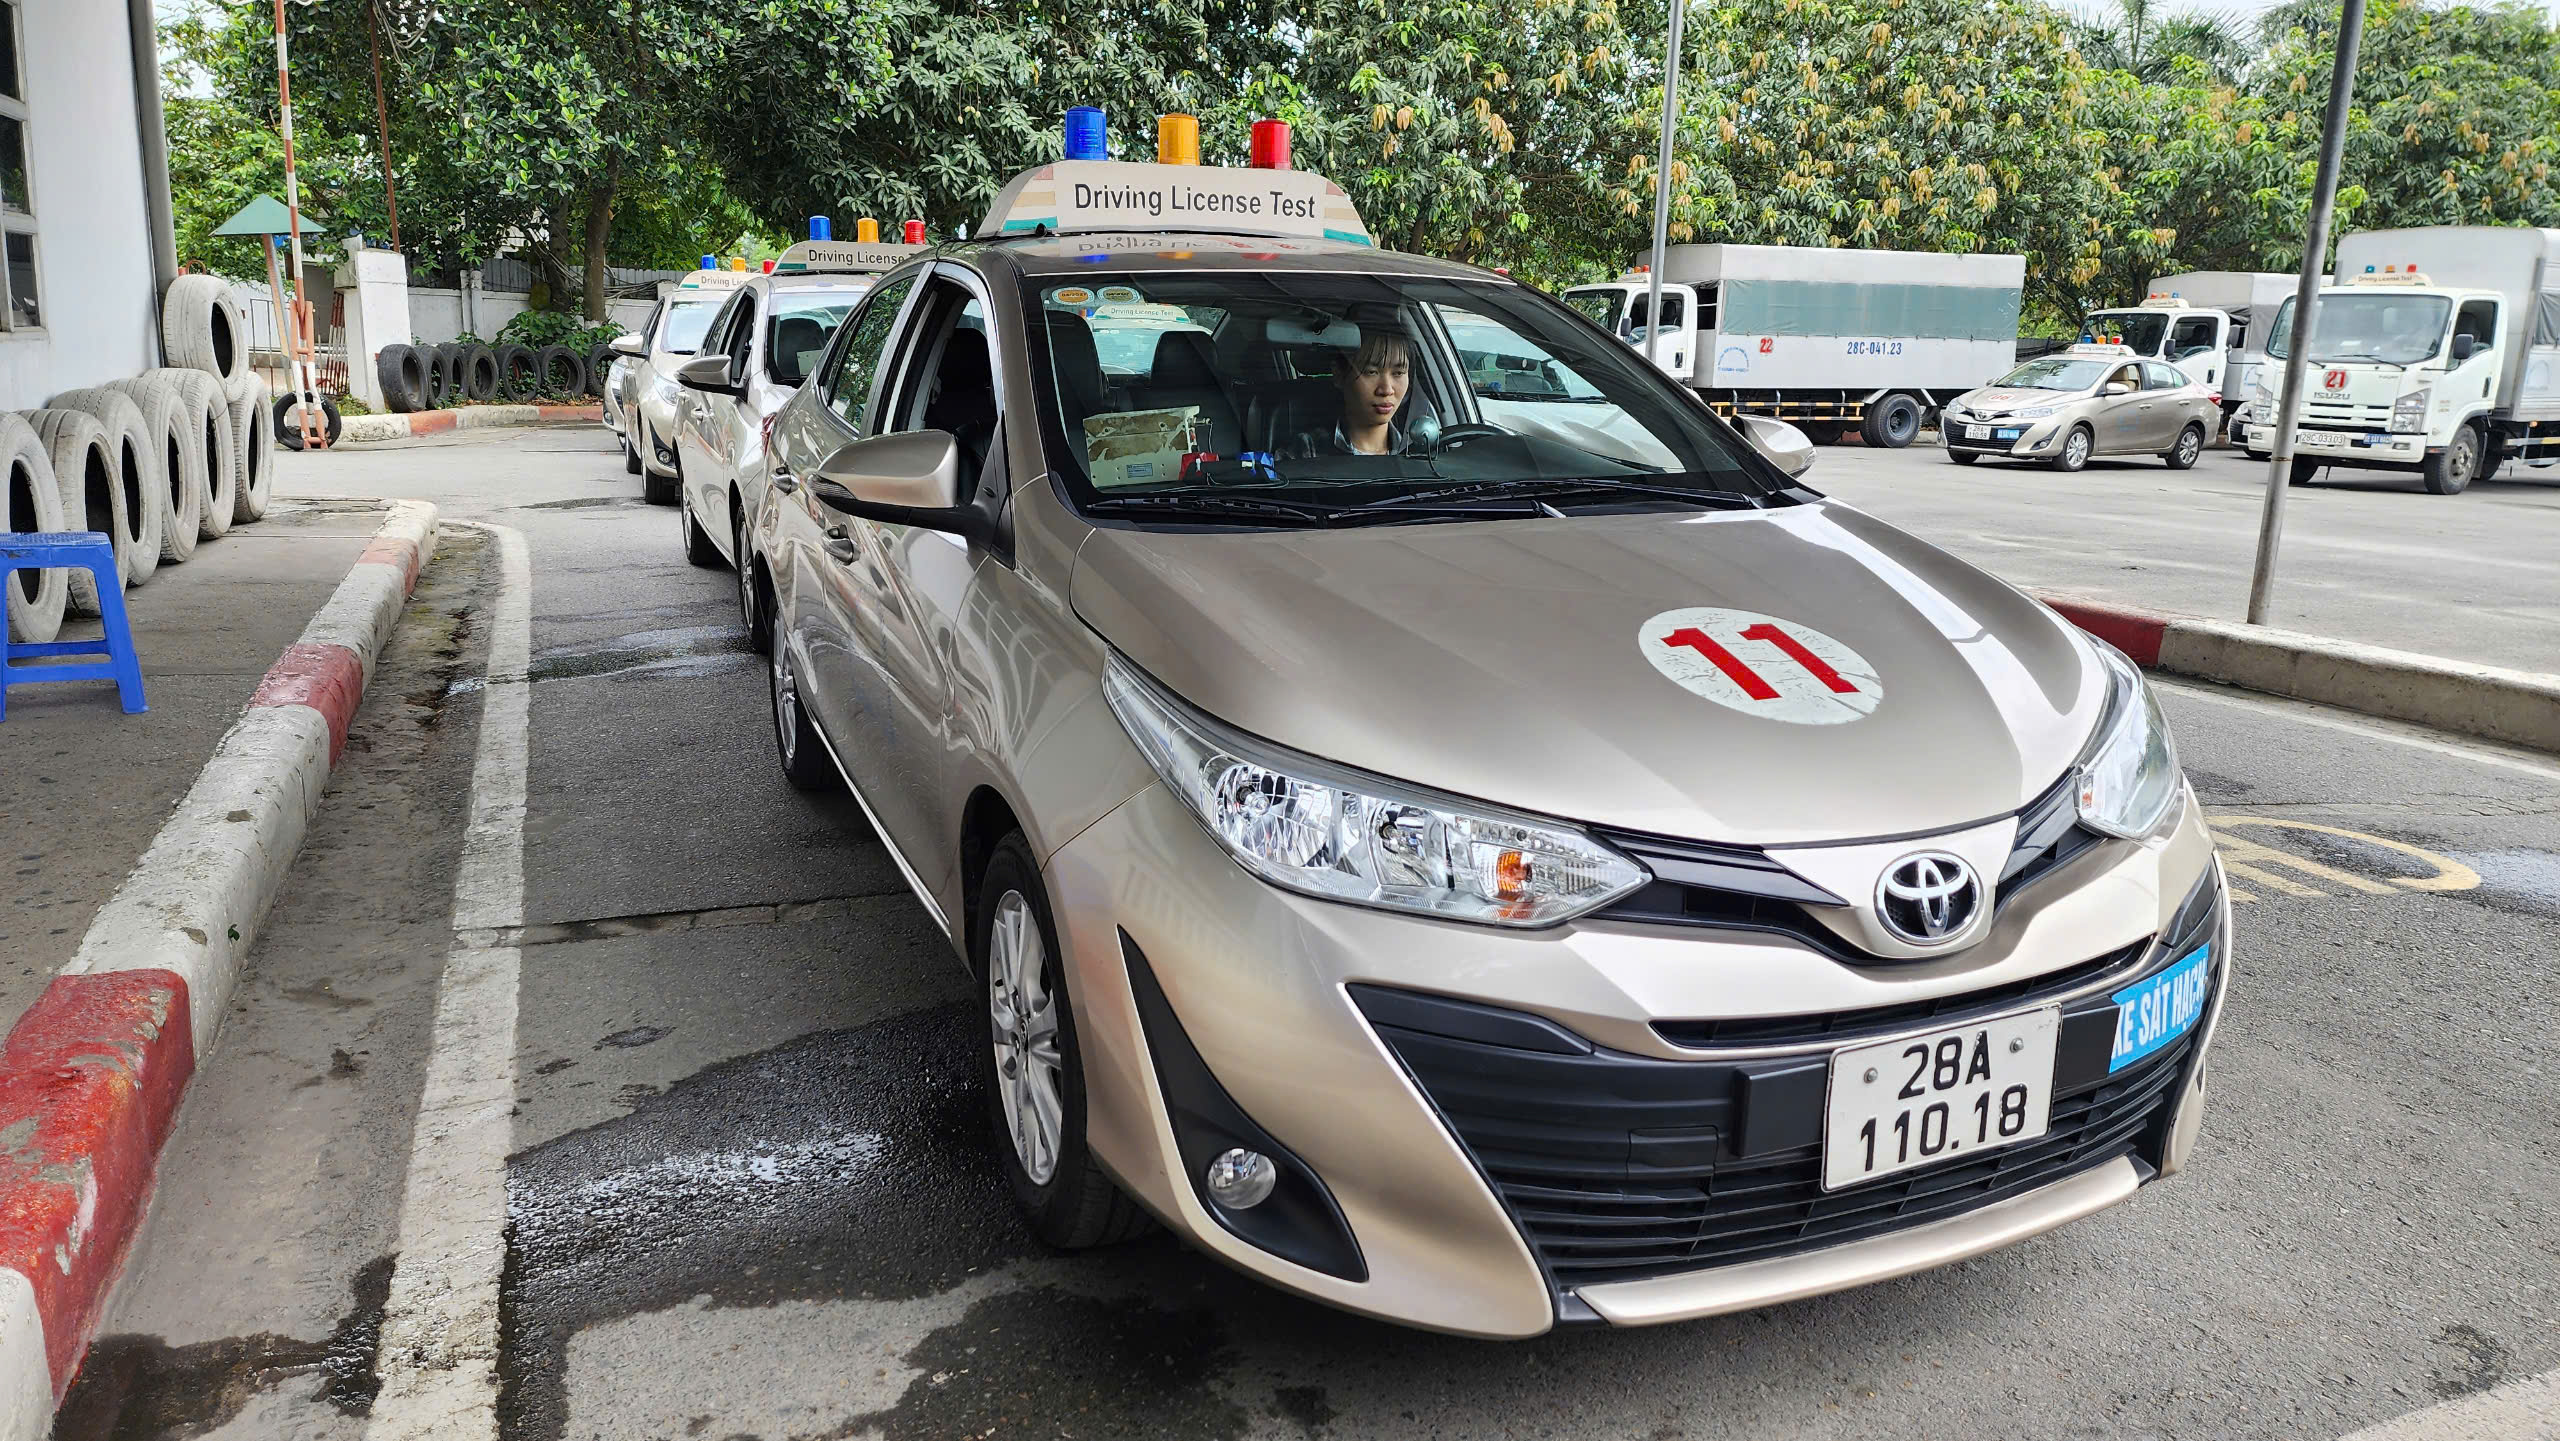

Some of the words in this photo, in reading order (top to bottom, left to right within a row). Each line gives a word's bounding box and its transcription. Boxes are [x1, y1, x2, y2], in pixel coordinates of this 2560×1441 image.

[1074, 183, 1162, 216] Driving
[1171, 185, 1261, 214] License
[1270, 191, 1315, 218] Test
[809, 249, 853, 265] Driving
[857, 251, 904, 265] License
[701, 275, 730, 287] Driving
[1111, 307, 1134, 316] Driving
[1760, 338, 1774, 353] 22
[1847, 341, 1902, 355] 28C-041.23
[2325, 371, 2347, 388] 21
[2314, 391, 2351, 400] ISUZU
[1660, 623, 1861, 701] 11
[2111, 1000, 2135, 1060] XE
[2138, 976, 2171, 1046] SÁT
[2171, 957, 2207, 1031] HẠCH
[1898, 1030, 1991, 1100] 28A
[1860, 1083, 2028, 1171] 110.18
